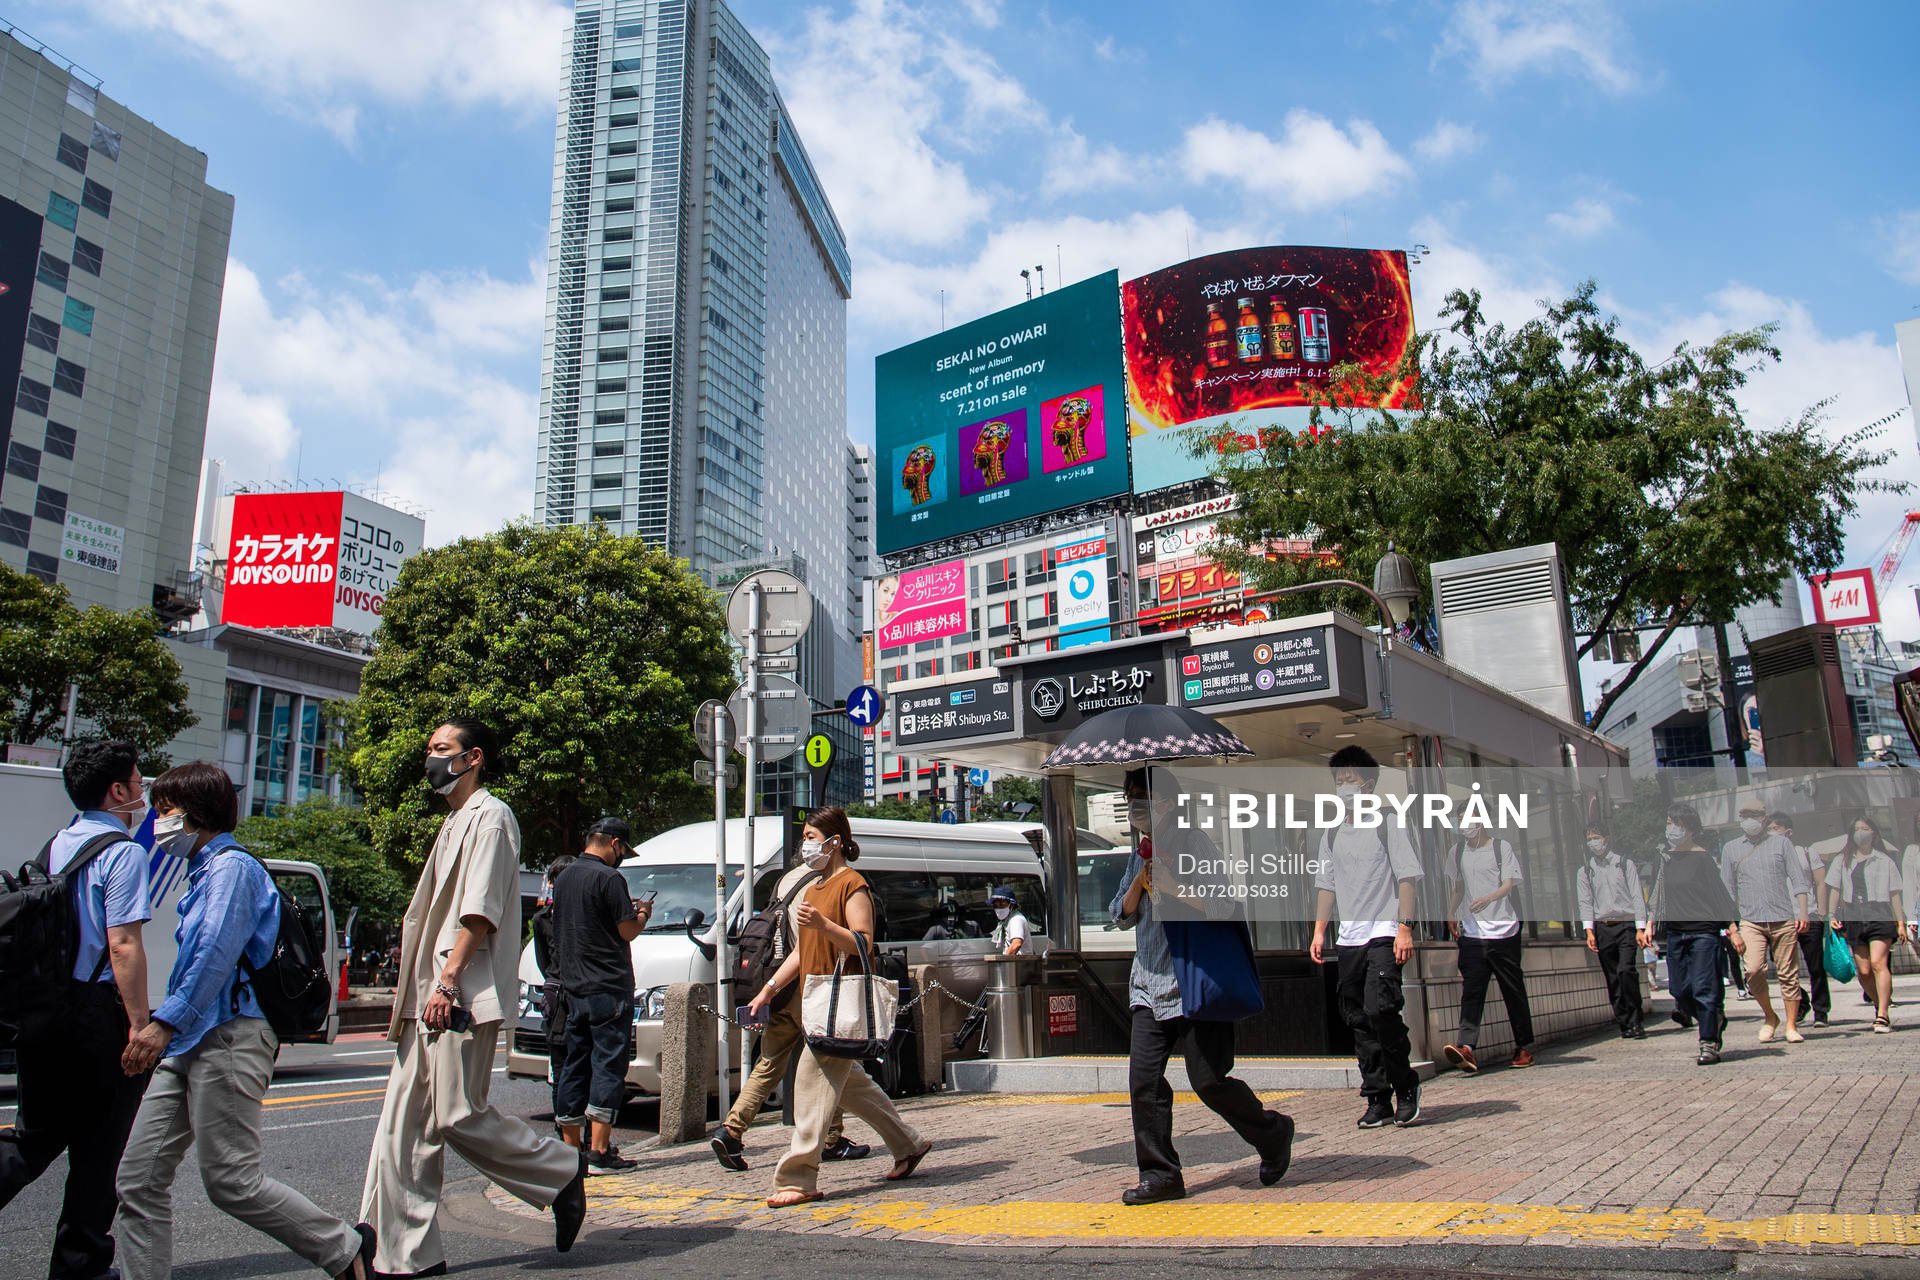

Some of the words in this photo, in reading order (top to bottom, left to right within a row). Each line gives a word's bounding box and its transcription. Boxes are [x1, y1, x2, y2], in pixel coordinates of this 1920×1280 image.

[936, 349, 973, 371] SEKAI
[977, 341, 997, 358] NO
[1000, 323, 1047, 349] OWARI
[969, 364, 985, 375] New
[988, 355, 1013, 369] Album
[940, 382, 973, 402] scent
[975, 376, 989, 390] of
[992, 359, 1045, 386] memory
[957, 398, 981, 416] 7.21
[1002, 385, 1027, 402] sale
[344, 516, 404, 554] ココロの
[233, 533, 334, 563] カラオケ
[1139, 541, 1154, 554] 9F
[77, 550, 117, 572] 東急建設
[230, 564, 333, 585] JOYSOUND
[916, 568, 960, 589] 品川スキン
[916, 582, 956, 601] クリニック
[1830, 588, 1859, 608] H&M
[1064, 600, 1102, 618] eyecity
[891, 611, 962, 640] 品川美容外科
[1273, 637, 1313, 653] 副都心線
[1274, 649, 1306, 661] Fukutoshin
[1307, 648, 1320, 656] Line
[1186, 661, 1198, 670] TY
[1201, 650, 1229, 664] 東横線
[1202, 663, 1222, 672] Toyoko
[1222, 661, 1235, 669] Line
[1069, 667, 1152, 698] しぶちか
[1188, 685, 1200, 695] DT
[1203, 673, 1249, 689] 田園都市線
[1204, 686, 1240, 697] Den-en-toshi
[1241, 684, 1254, 692] Line
[1276, 676, 1308, 687] Hanzomon
[1078, 693, 1142, 711] SHIBUCHIKA
[917, 711, 957, 731] 渋谷駅
[959, 713, 991, 726] Shibuya
[993, 710, 1010, 721] Sta.
